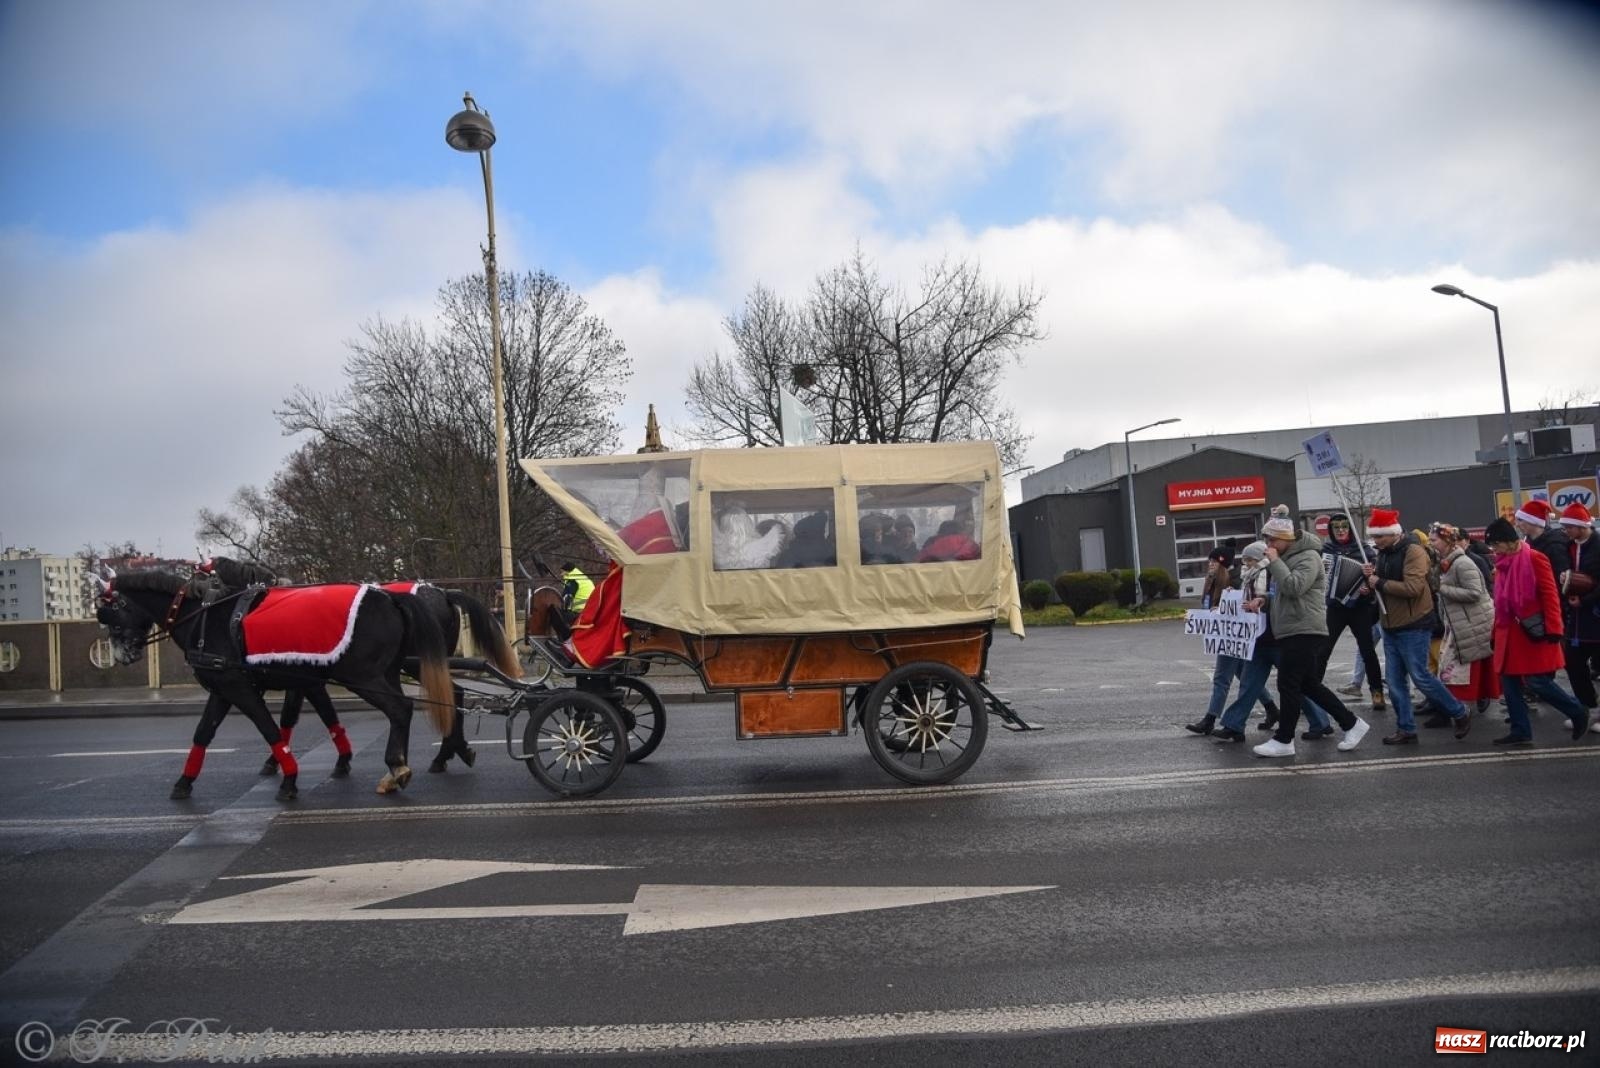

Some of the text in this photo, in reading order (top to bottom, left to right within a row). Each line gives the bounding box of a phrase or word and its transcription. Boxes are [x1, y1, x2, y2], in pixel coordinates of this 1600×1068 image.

[1178, 485, 1254, 498] MYJNIA WYJAZD
[1556, 492, 1592, 507] DKV
